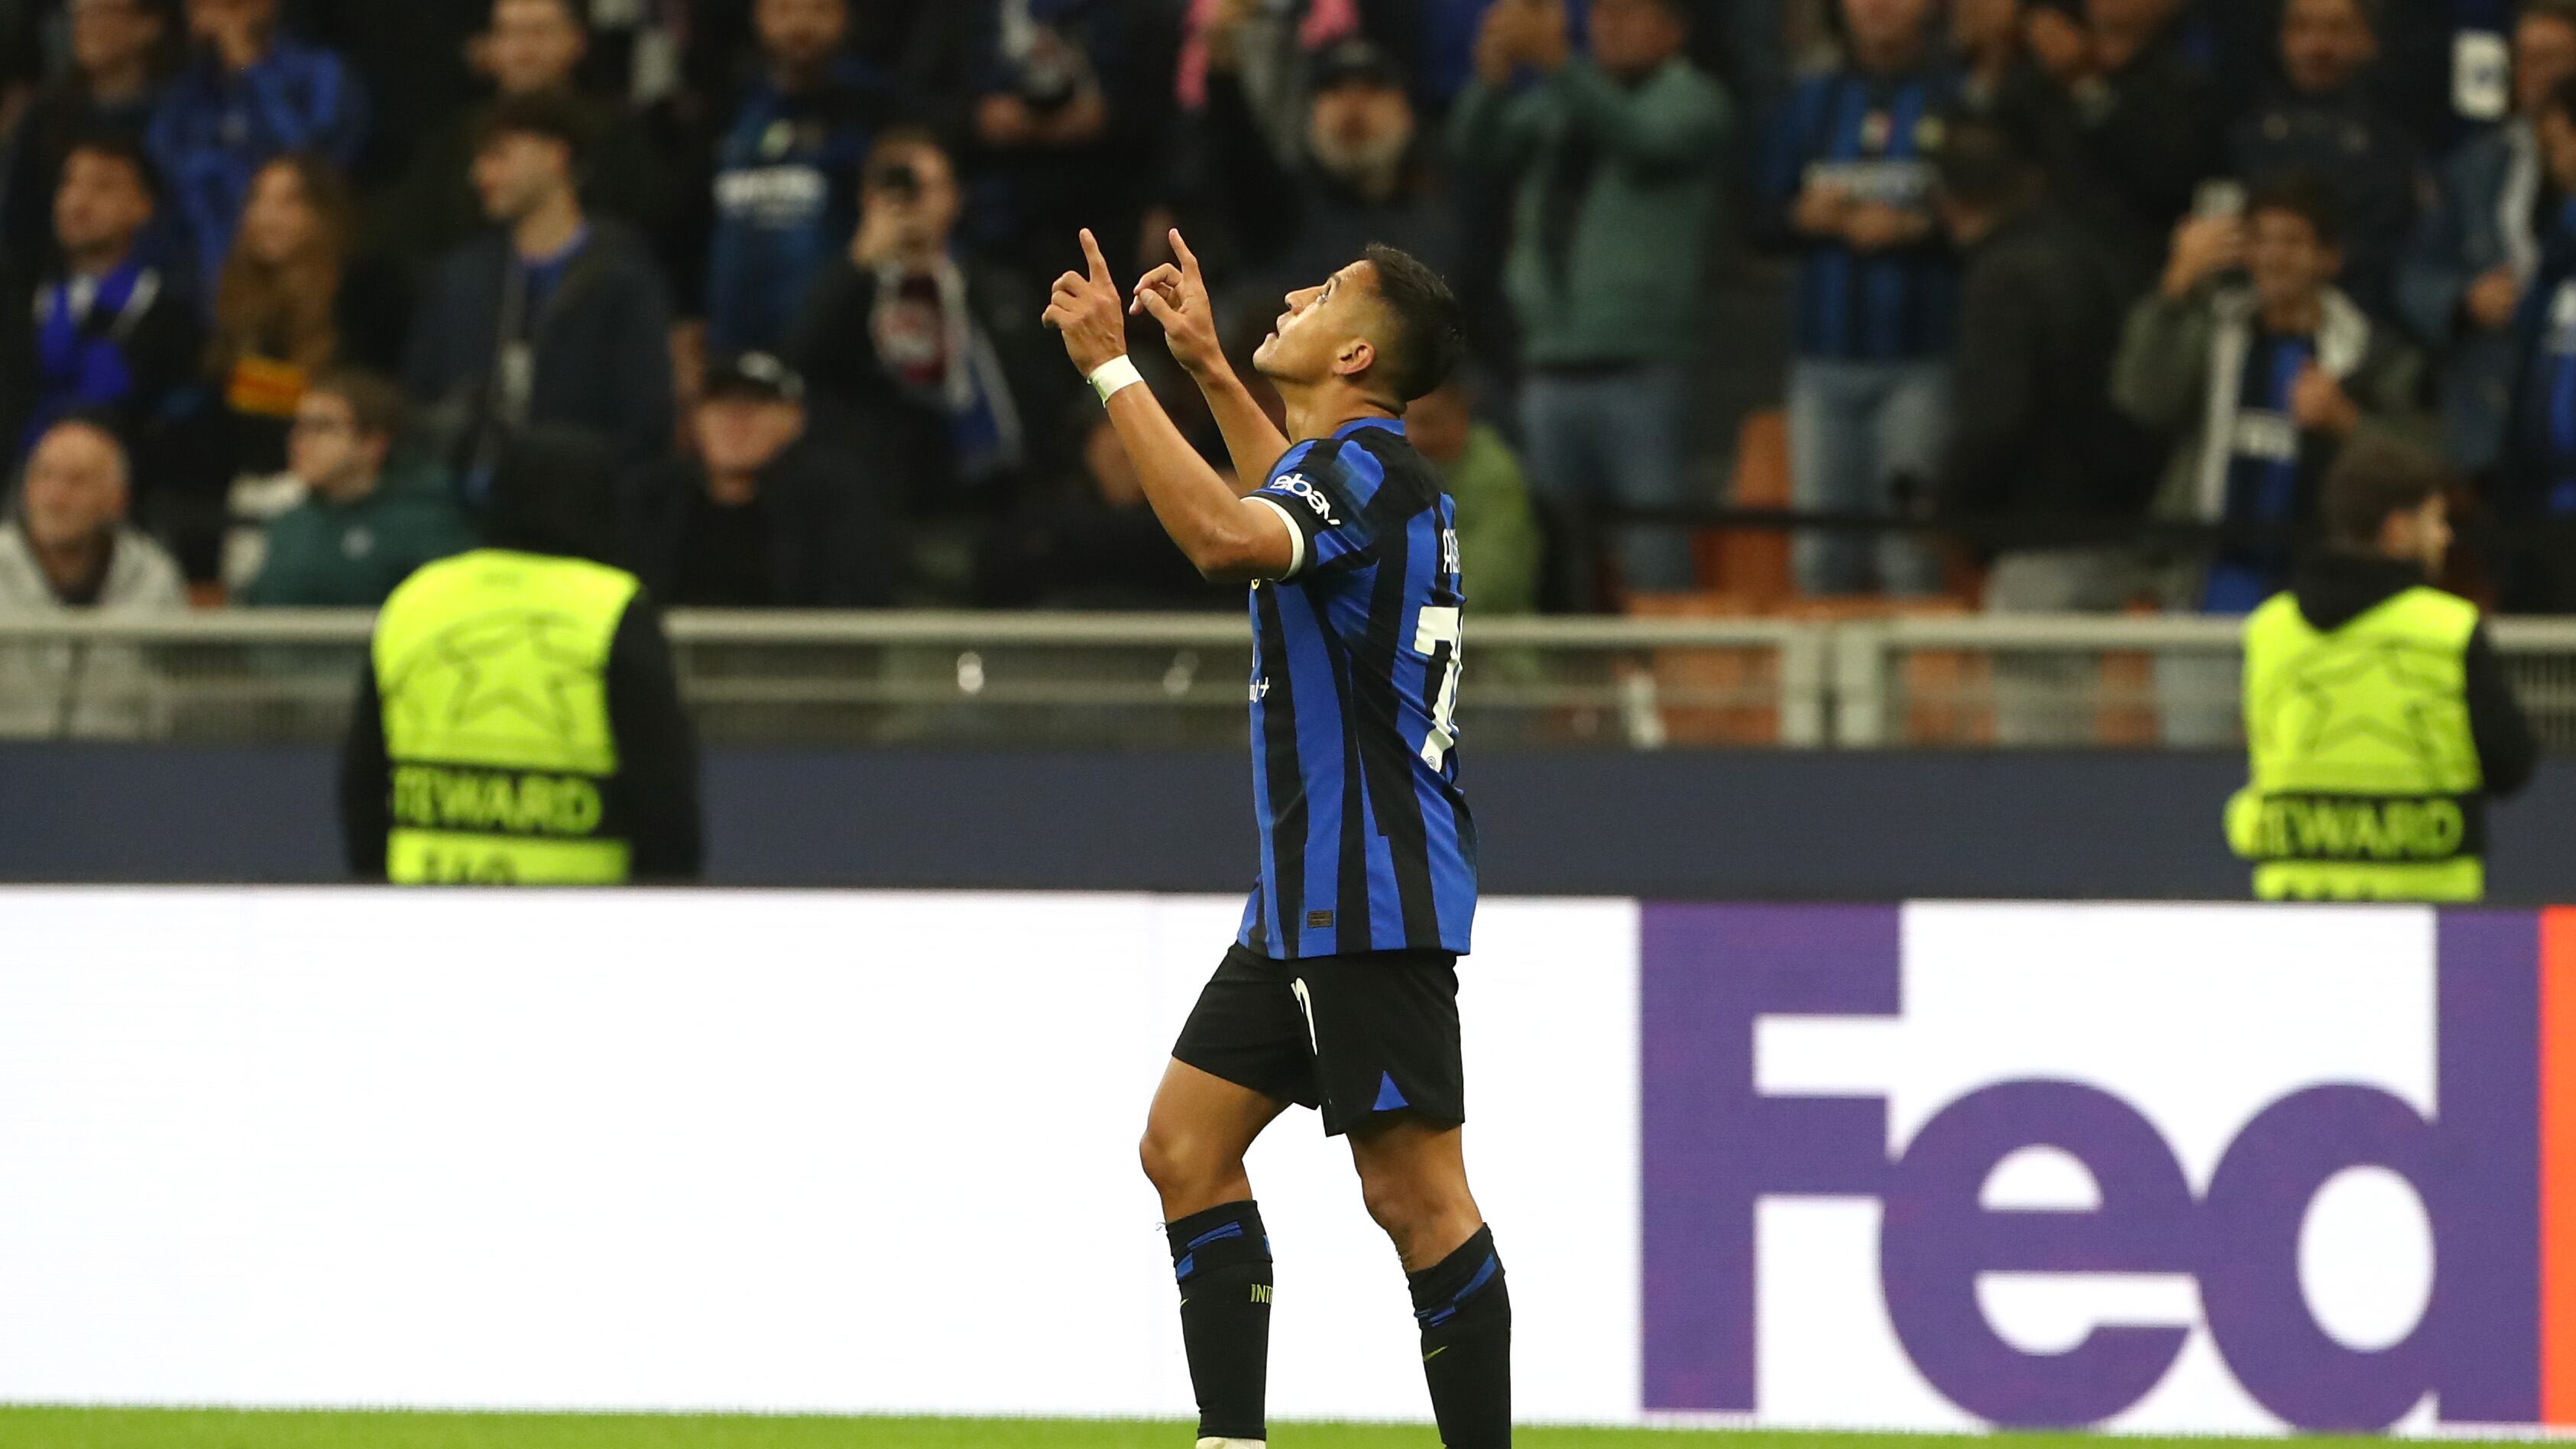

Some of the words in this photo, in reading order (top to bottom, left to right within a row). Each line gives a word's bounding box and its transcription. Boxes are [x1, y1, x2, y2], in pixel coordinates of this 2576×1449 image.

[1414, 606, 1463, 774] 7
[392, 767, 602, 835] TEWARD
[1640, 903, 2576, 1432] Fed
